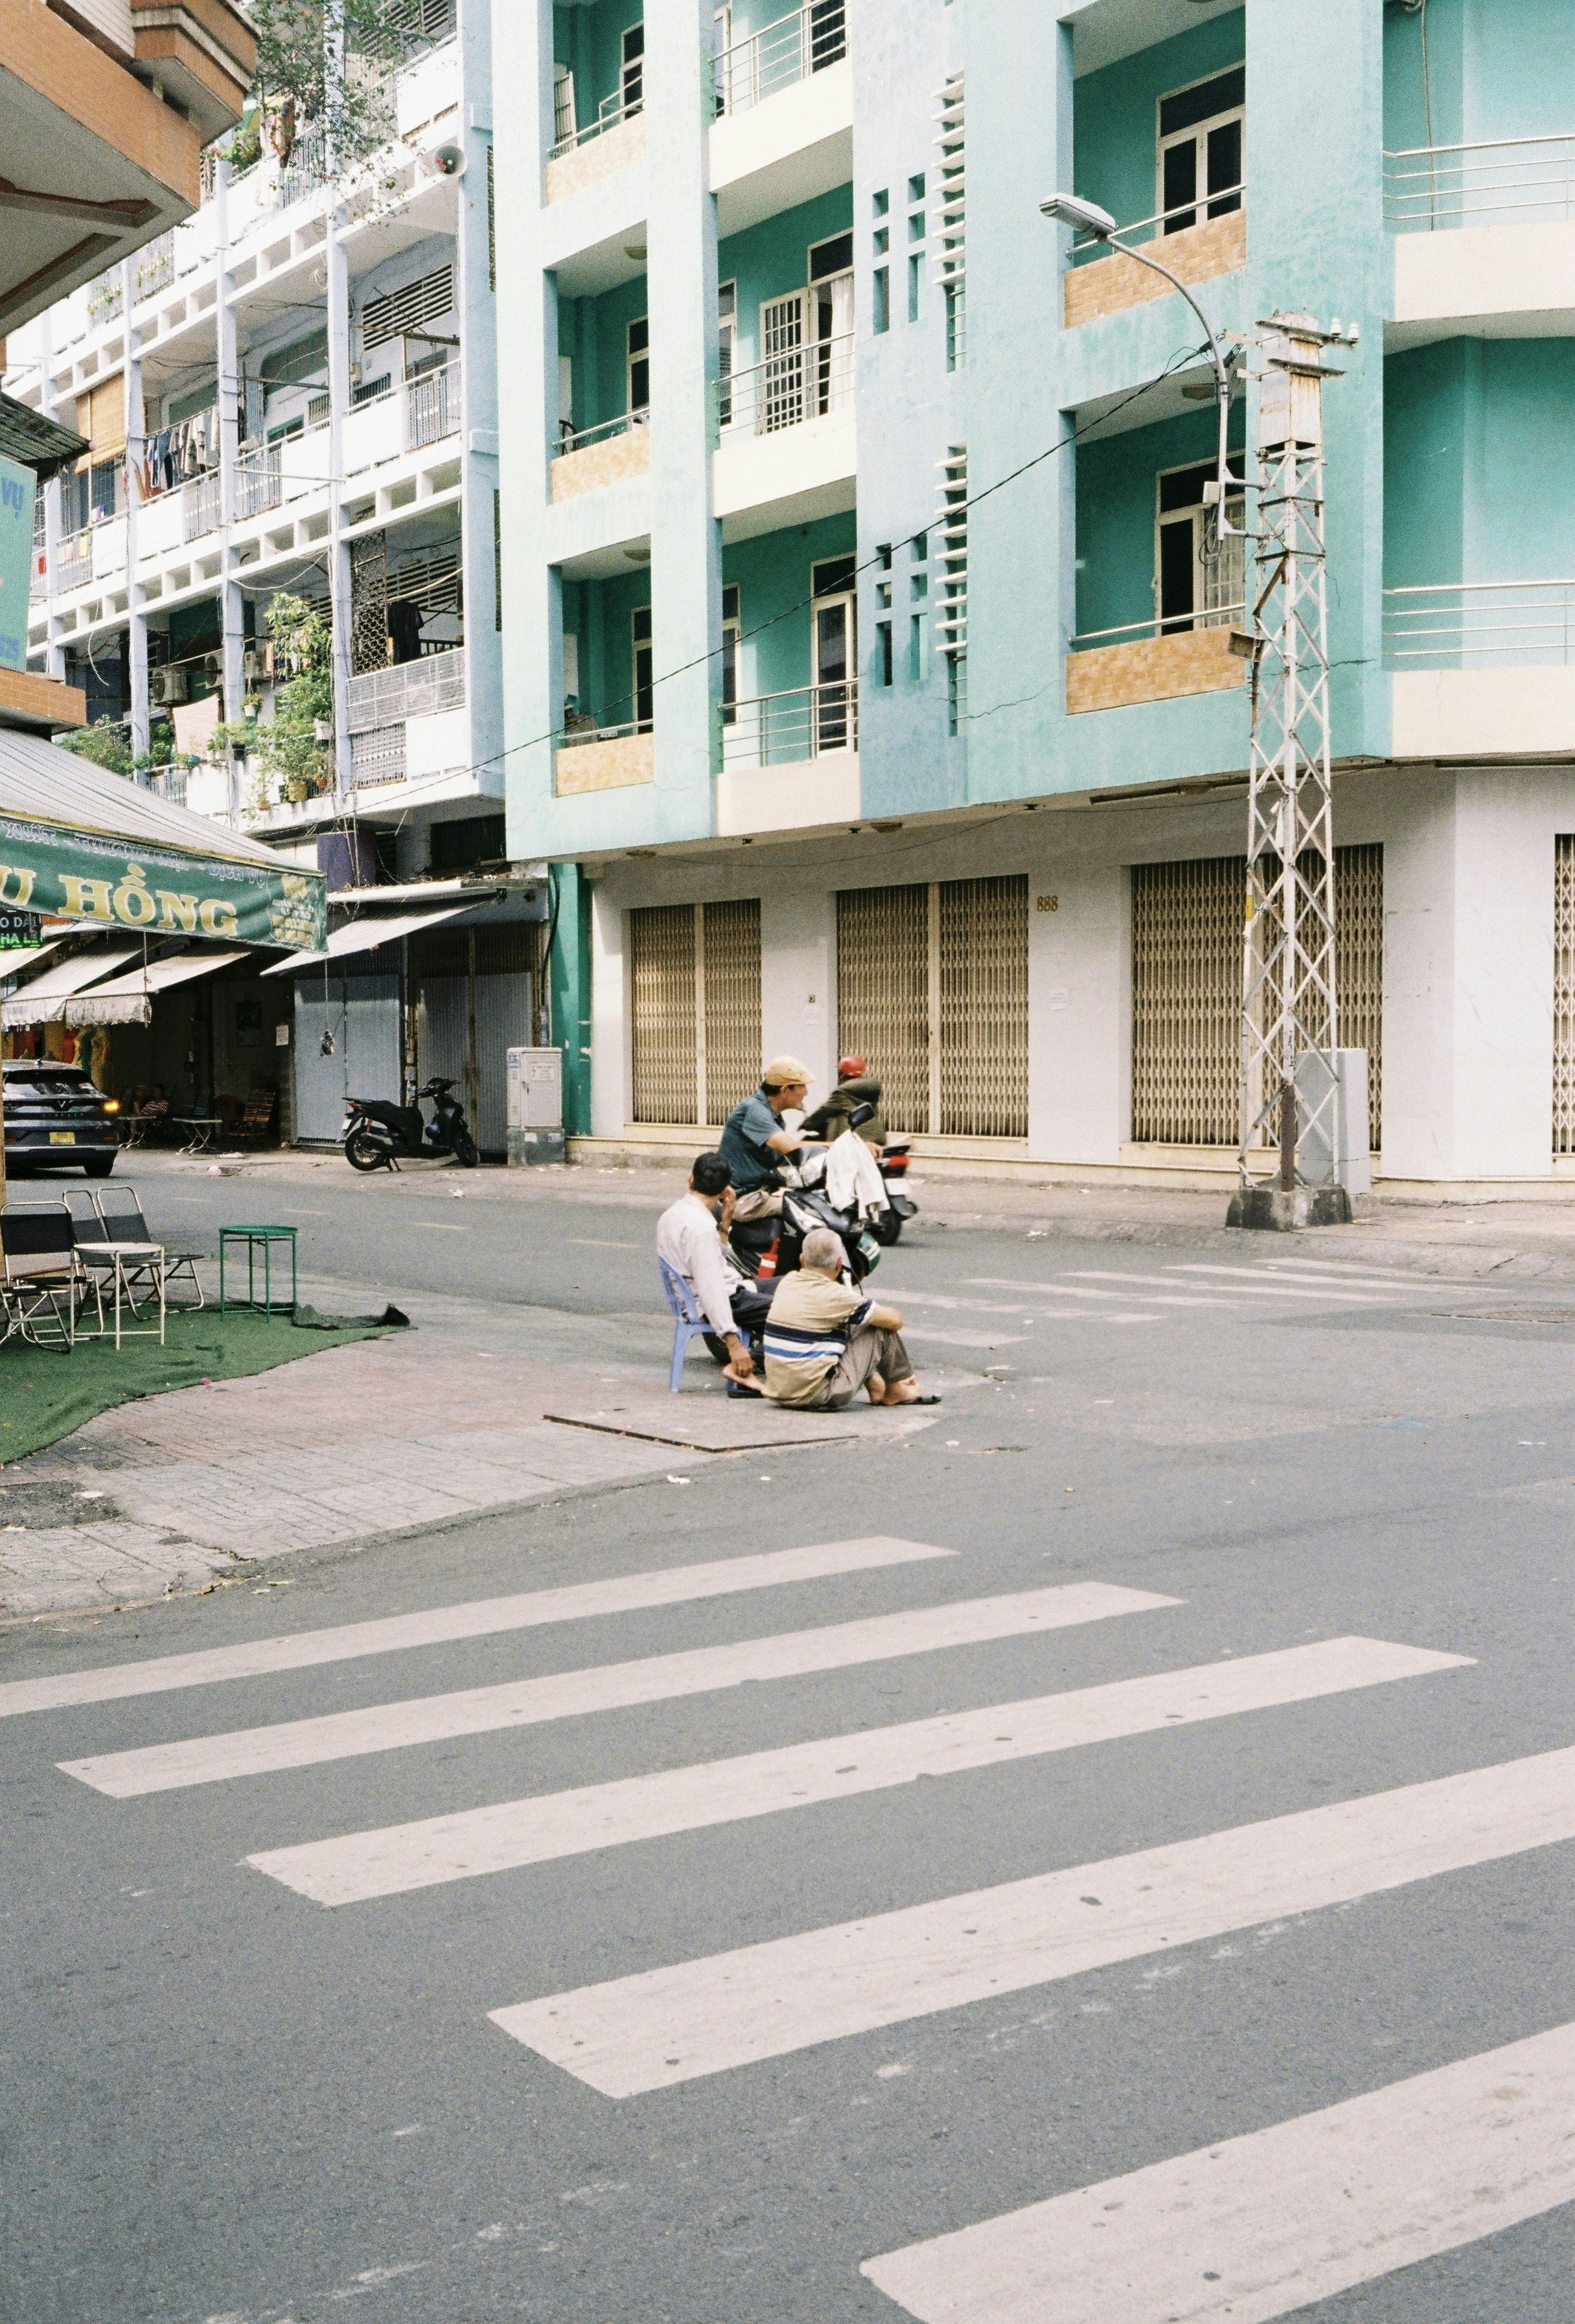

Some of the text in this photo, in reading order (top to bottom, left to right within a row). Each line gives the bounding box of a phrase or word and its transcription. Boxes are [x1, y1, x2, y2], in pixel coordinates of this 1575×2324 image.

[2, 477, 24, 518] VỤ
[58, 863, 238, 937] HỒNG
[1037, 896, 1058, 912] 888
